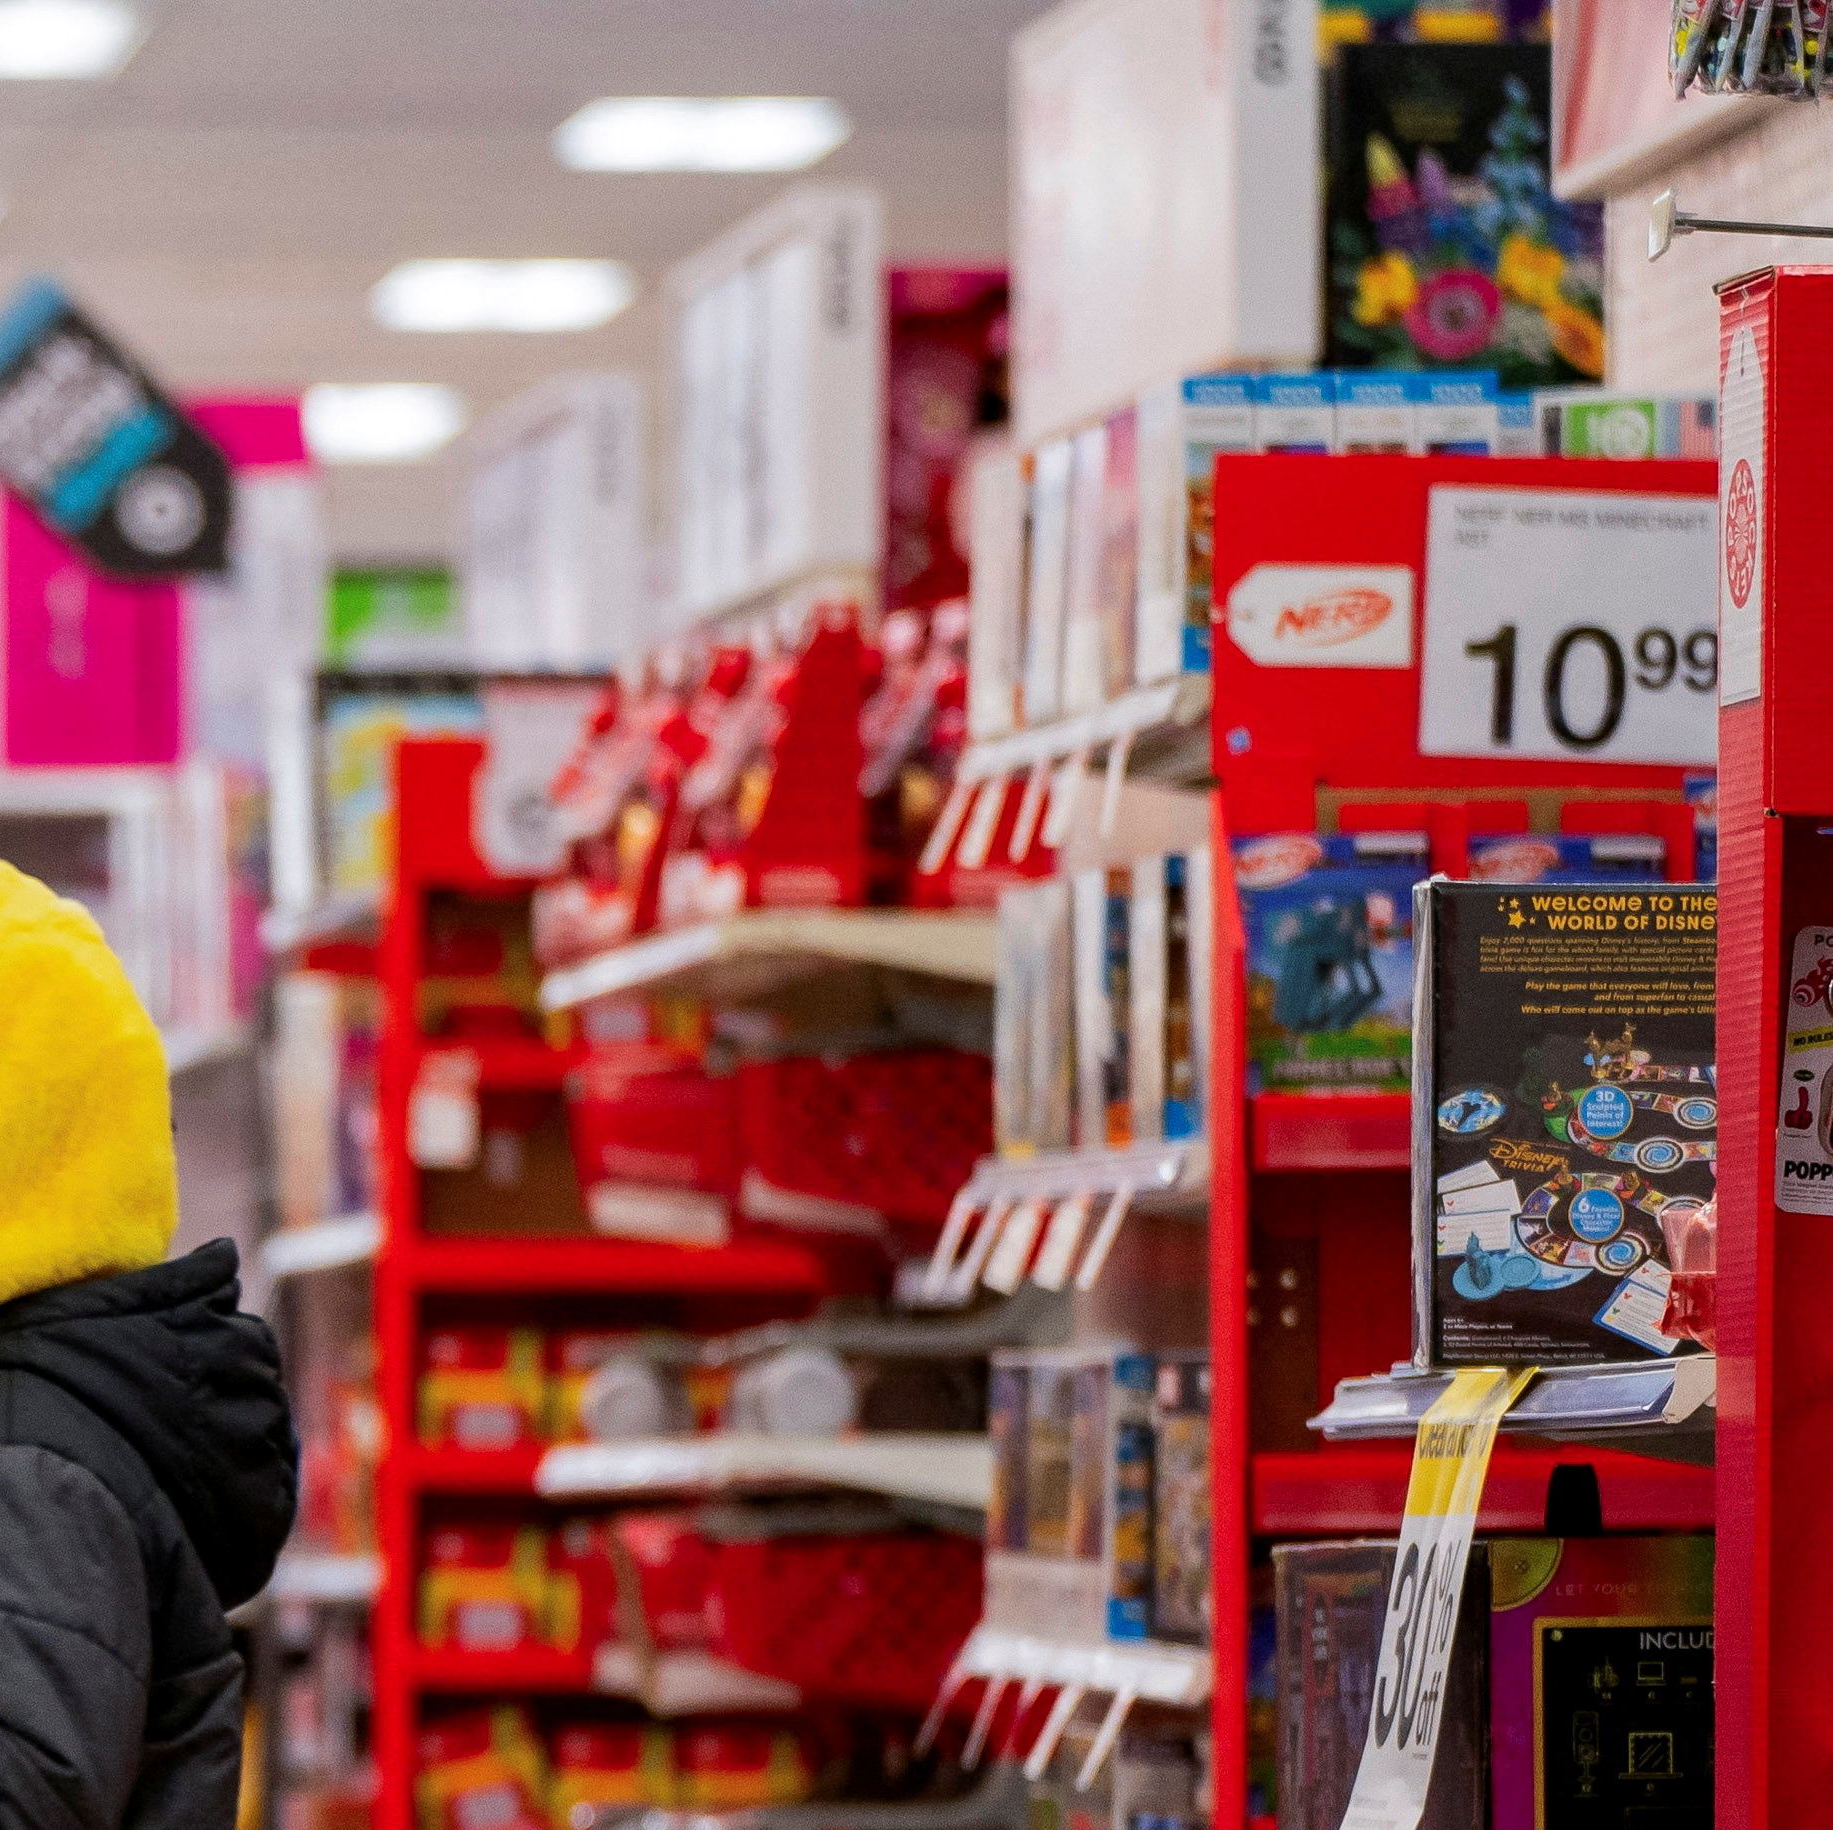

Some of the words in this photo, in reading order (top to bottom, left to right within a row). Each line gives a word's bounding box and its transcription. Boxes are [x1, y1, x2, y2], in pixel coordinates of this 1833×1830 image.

[1273, 590, 1394, 642] NERF
[1531, 896, 1643, 912] WELCOME
[1648, 896, 1673, 912] TO
[1678, 896, 1717, 912] THE
[1547, 915, 1619, 931] WORLD
[1624, 915, 1650, 931] OF
[1655, 915, 1717, 931] DISNE
[1524, 981, 1544, 992] Play
[1546, 981, 1561, 992] the
[1562, 981, 1588, 992] game
[1589, 981, 1608, 992] that
[1609, 981, 1650, 992] everyone
[1651, 981, 1669, 992] will
[1693, 981, 1715, 992] from
[1593, 992, 1612, 1003] and
[1613, 992, 1634, 1003] from
[1636, 992, 1675, 1003] superfan
[1676, 992, 1686, 1003] to
[1521, 1004, 1543, 1015] Who
[1543, 1004, 1560, 1015] will
[1562, 1004, 1586, 1015] come
[1588, 1004, 1603, 1015] out
[1605, 1004, 1617, 1015] on
[1618, 1004, 1634, 1015] top
[1635, 1004, 1646, 1015] as
[1647, 1004, 1662, 1015] the
[1663, 1004, 1695, 1015] game's
[1793, 1034, 1806, 1047] NO
[1595, 1090, 1615, 1103] 3D
[1502, 1159, 1545, 1173] TRIVIA
[1578, 1197, 1590, 1214] 6
[1374, 1539, 1462, 1750] 30%
[1415, 1670, 1443, 1748] off
